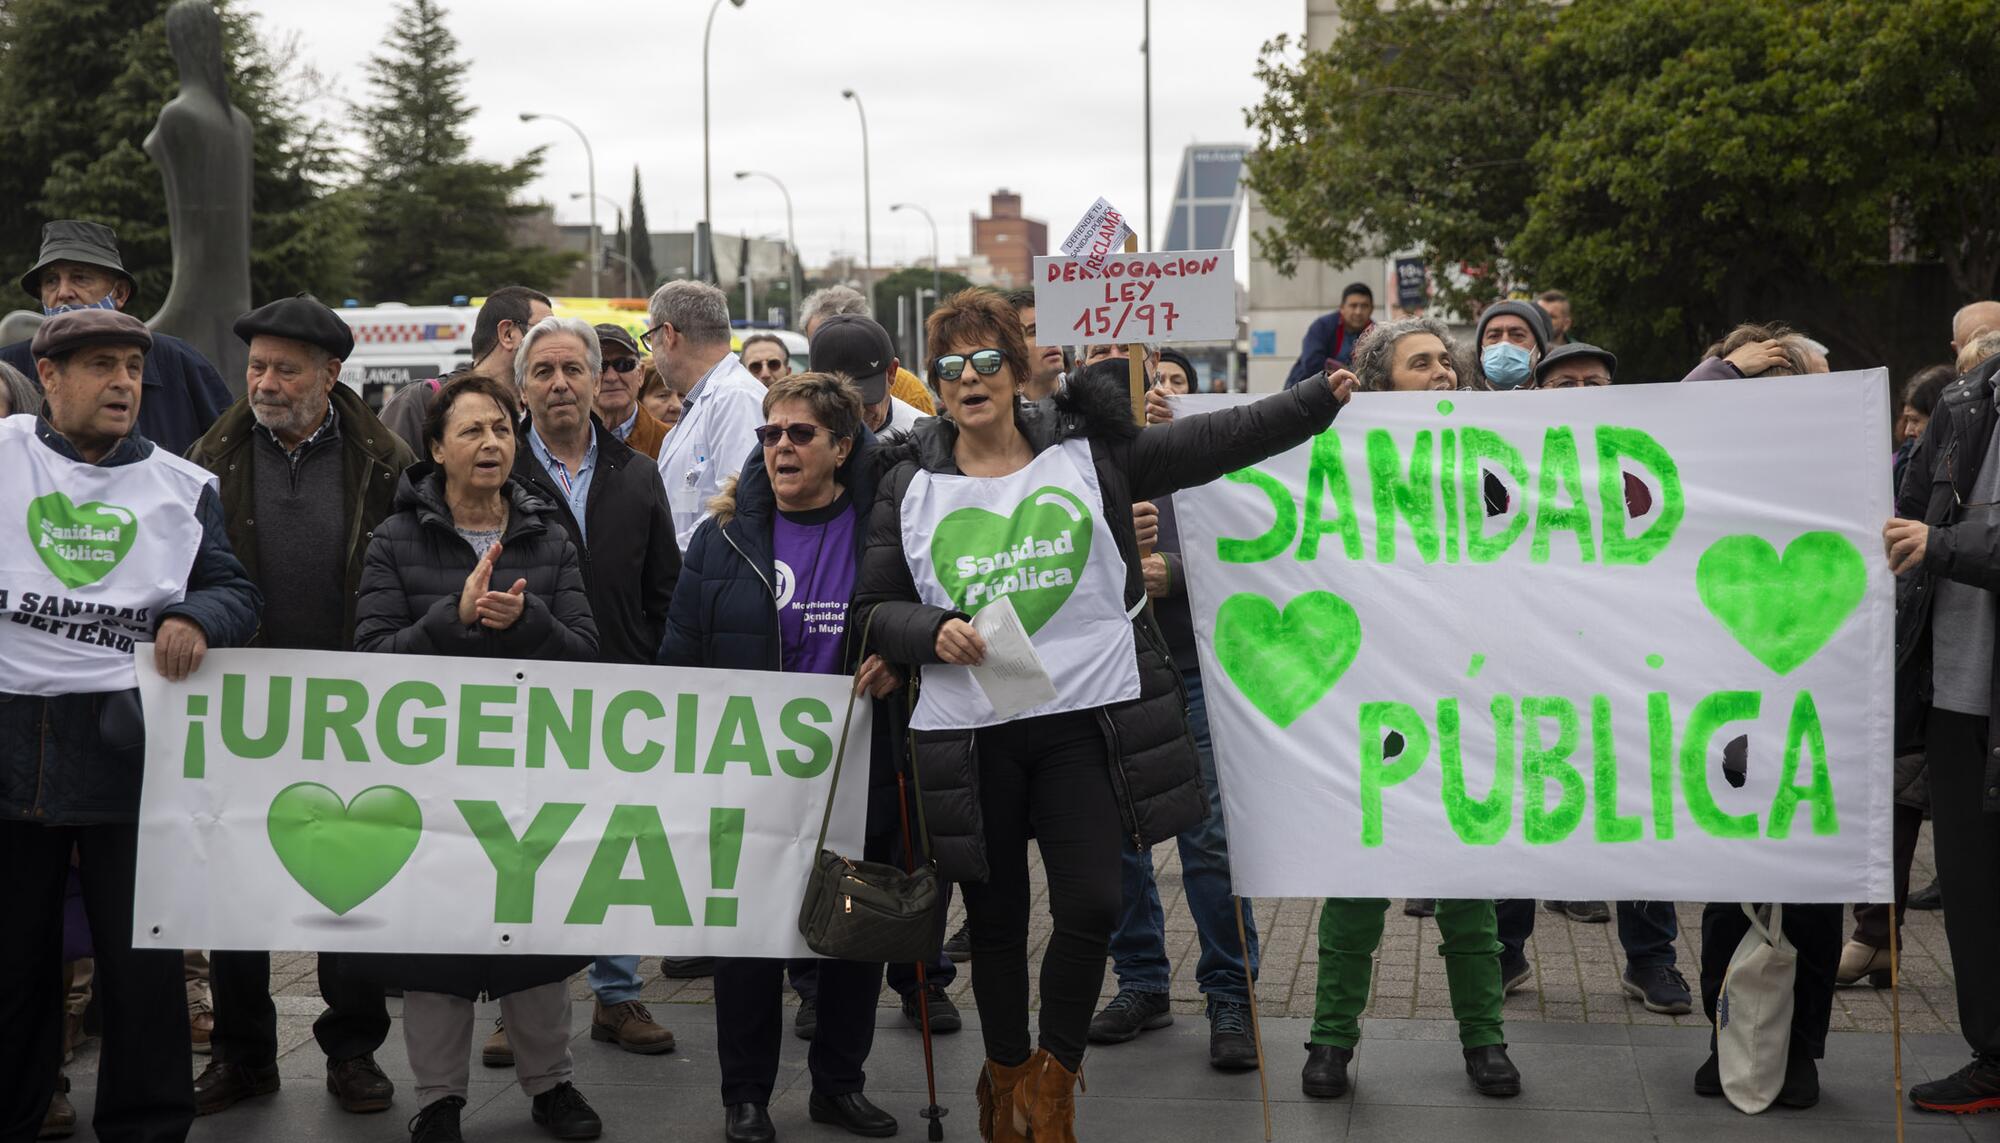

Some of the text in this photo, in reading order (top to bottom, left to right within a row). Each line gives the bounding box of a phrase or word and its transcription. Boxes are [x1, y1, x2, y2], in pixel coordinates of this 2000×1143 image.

[1066, 203, 1103, 248] DEFIENDE TU
[1071, 229, 1094, 258] SANIDAD
[1086, 211, 1121, 271] RECLAMA
[1105, 280, 1154, 303] LEY
[1073, 302, 1180, 338] 15/97
[40, 518, 120, 542] Sanidad
[40, 533, 115, 562] Pública
[956, 530, 1074, 579] Sanidad
[965, 566, 1073, 606] Pública
[819, 624, 844, 635] Muje
[183, 672, 834, 779] ¡URGENCIAS
[453, 799, 747, 928] YA!
